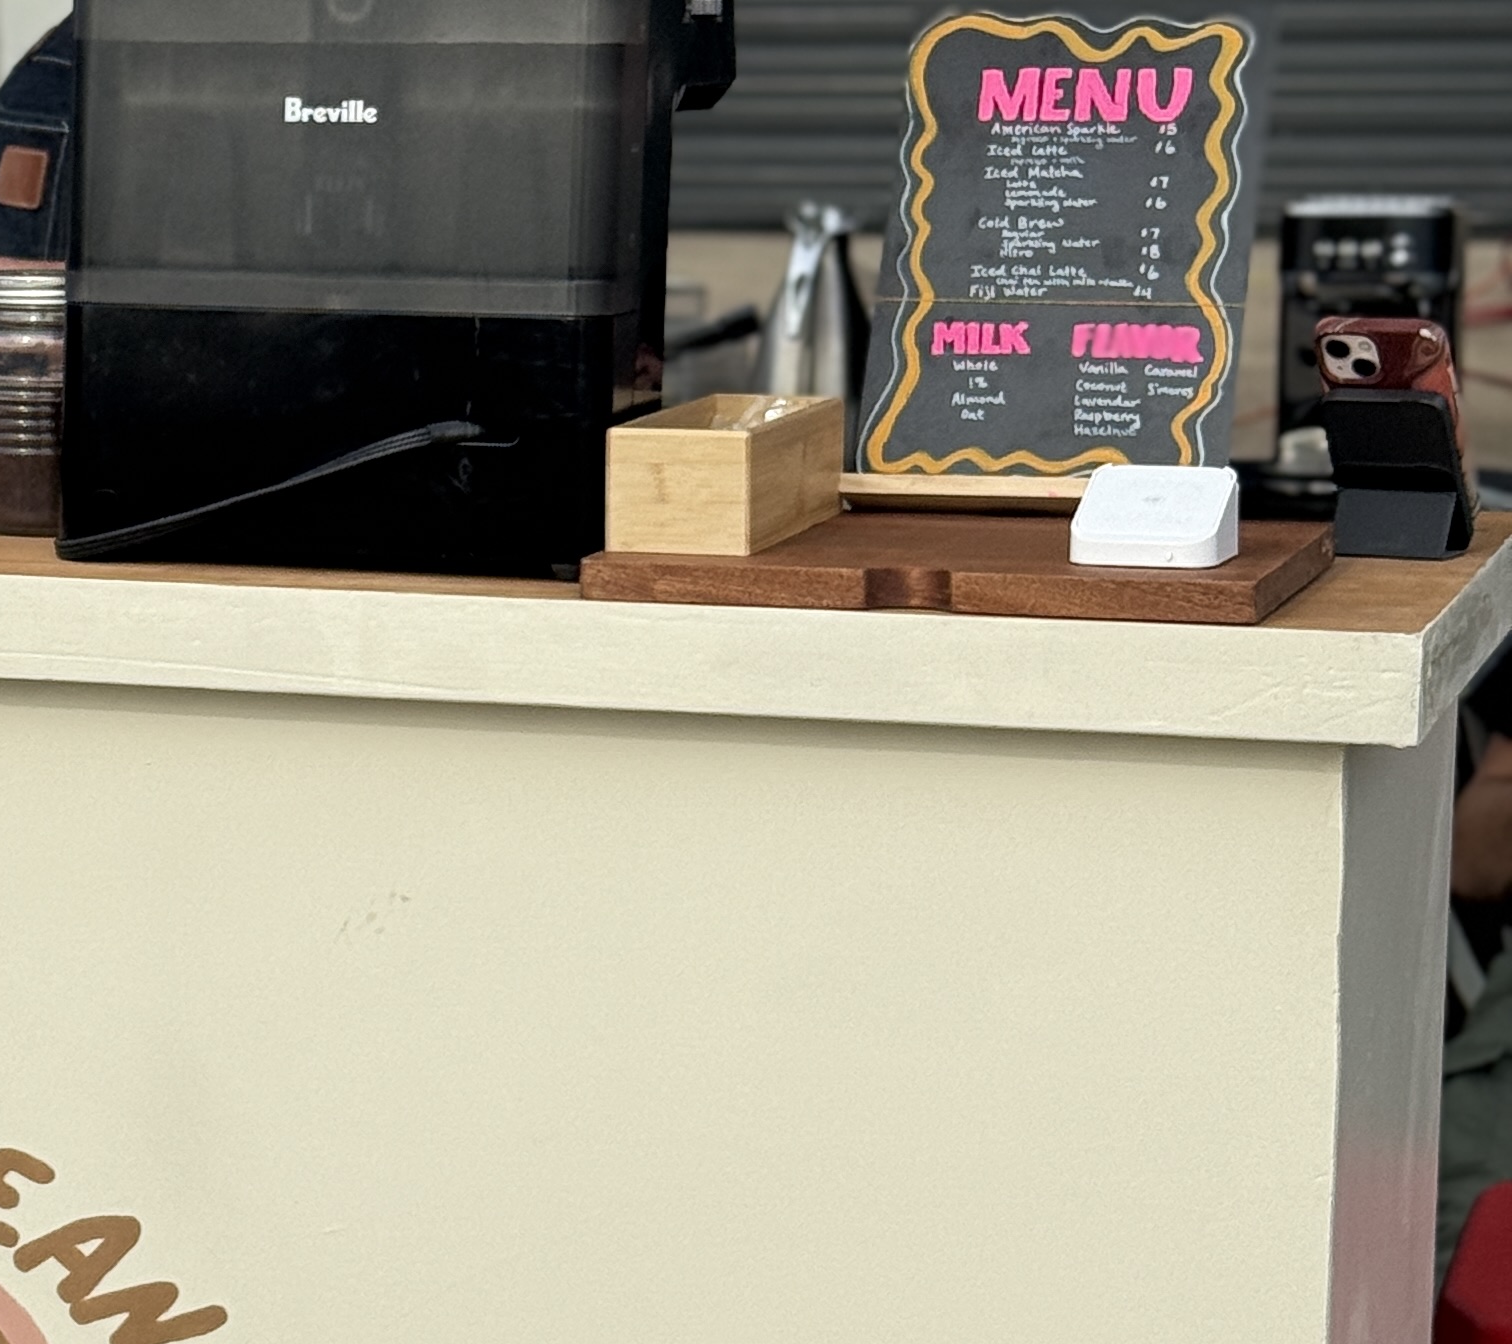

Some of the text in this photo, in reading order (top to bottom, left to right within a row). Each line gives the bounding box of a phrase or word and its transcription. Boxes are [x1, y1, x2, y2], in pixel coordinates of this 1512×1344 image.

[978, 67, 1193, 122] MENU
[284, 97, 378, 124] Breville
[991, 123, 1061, 136] American
[1066, 123, 1121, 139] Sparkle
[987, 144, 1023, 156] Iced
[1032, 144, 1068, 156] Latte
[984, 166, 1084, 179] Iced Matcha
[978, 216, 1065, 230] Cold Brew
[970, 265, 1006, 277] Iced
[1049, 265, 1087, 278] Latte
[1003, 285, 1048, 298] Water
[931, 321, 1031, 355] MILK
[952, 360, 999, 372] Whole
[1078, 361, 1129, 375] Vanilla
[1144, 364, 1198, 378] Caramel
[1075, 379, 1127, 394] Coconut
[951, 391, 1006, 406] Almond
[1074, 409, 1141, 430] Raspberry
[1074, 424, 1138, 438] Hazelnut
